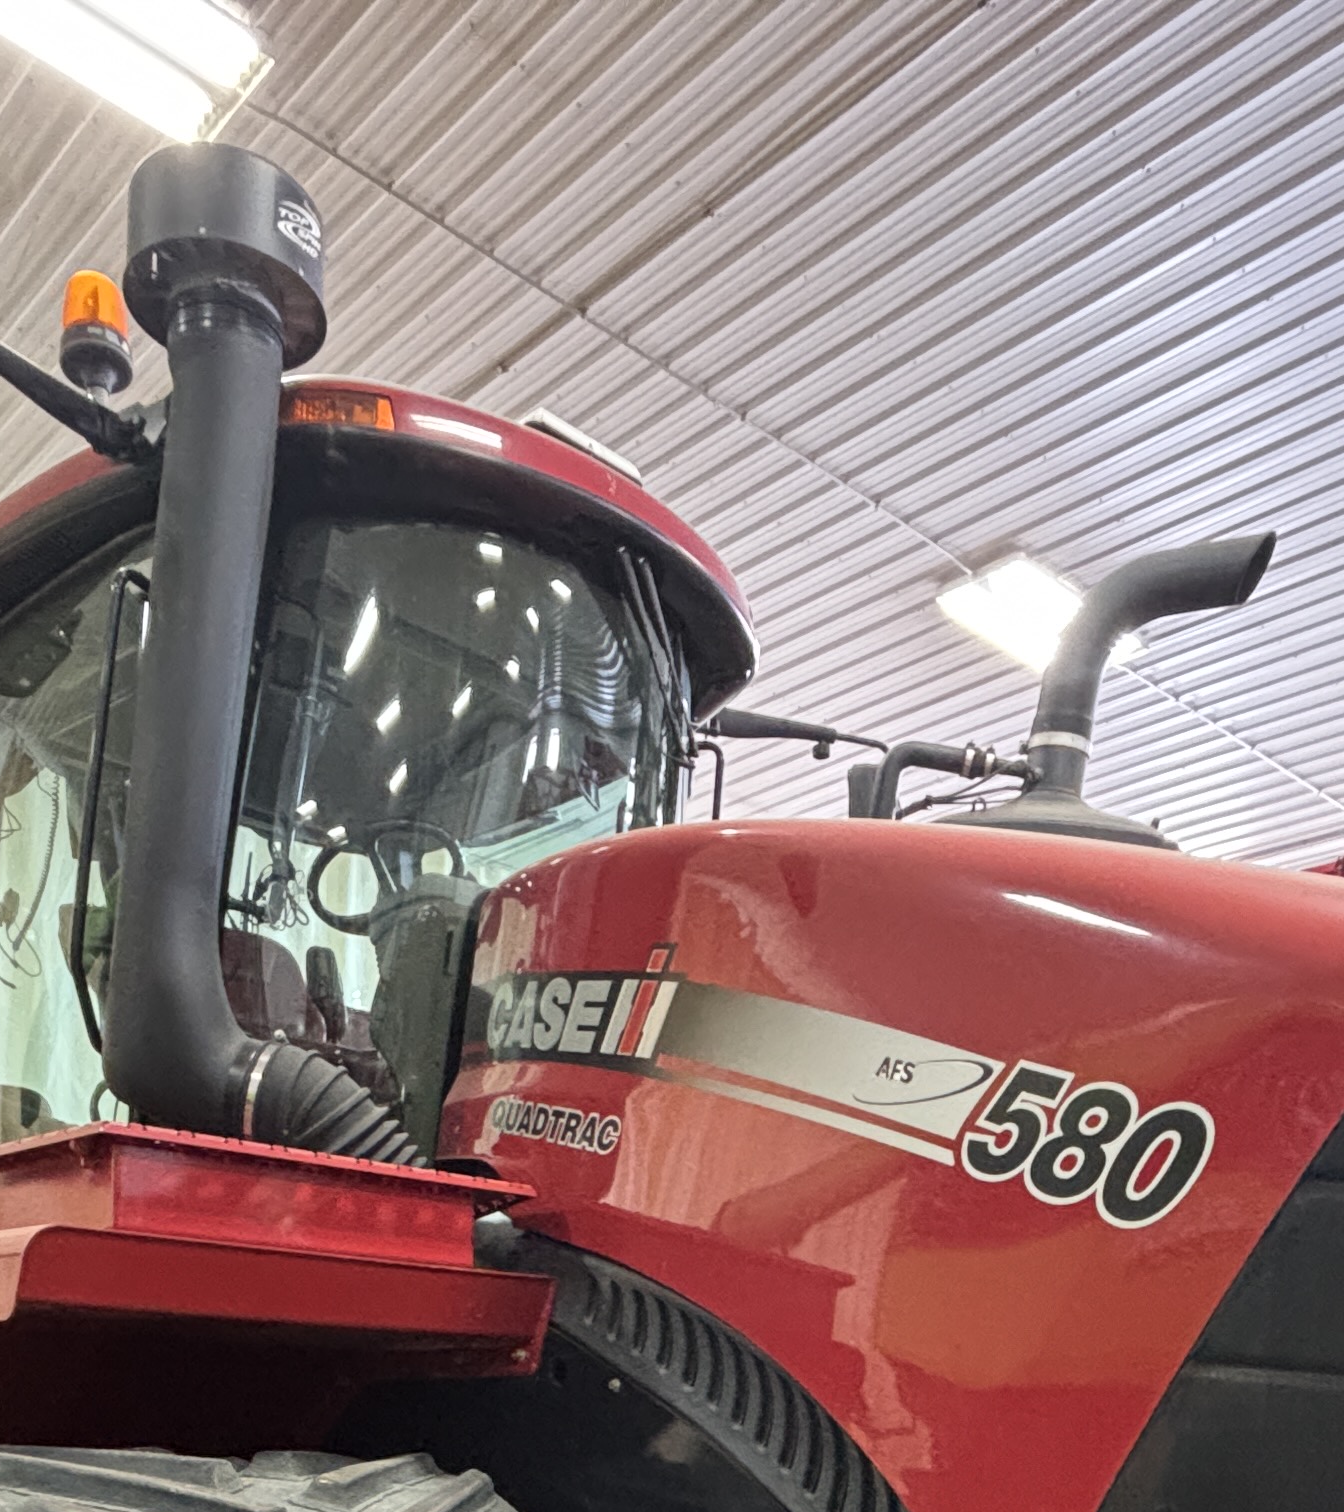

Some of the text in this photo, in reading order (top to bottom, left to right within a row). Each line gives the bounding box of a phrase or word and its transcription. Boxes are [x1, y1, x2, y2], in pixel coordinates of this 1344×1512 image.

[278, 206, 310, 226] TOP
[487, 977, 613, 1054] CASE
[875, 1056, 916, 1084] AFS
[492, 1097, 622, 1155] QUADTRAC
[962, 1060, 1215, 1229] 580
